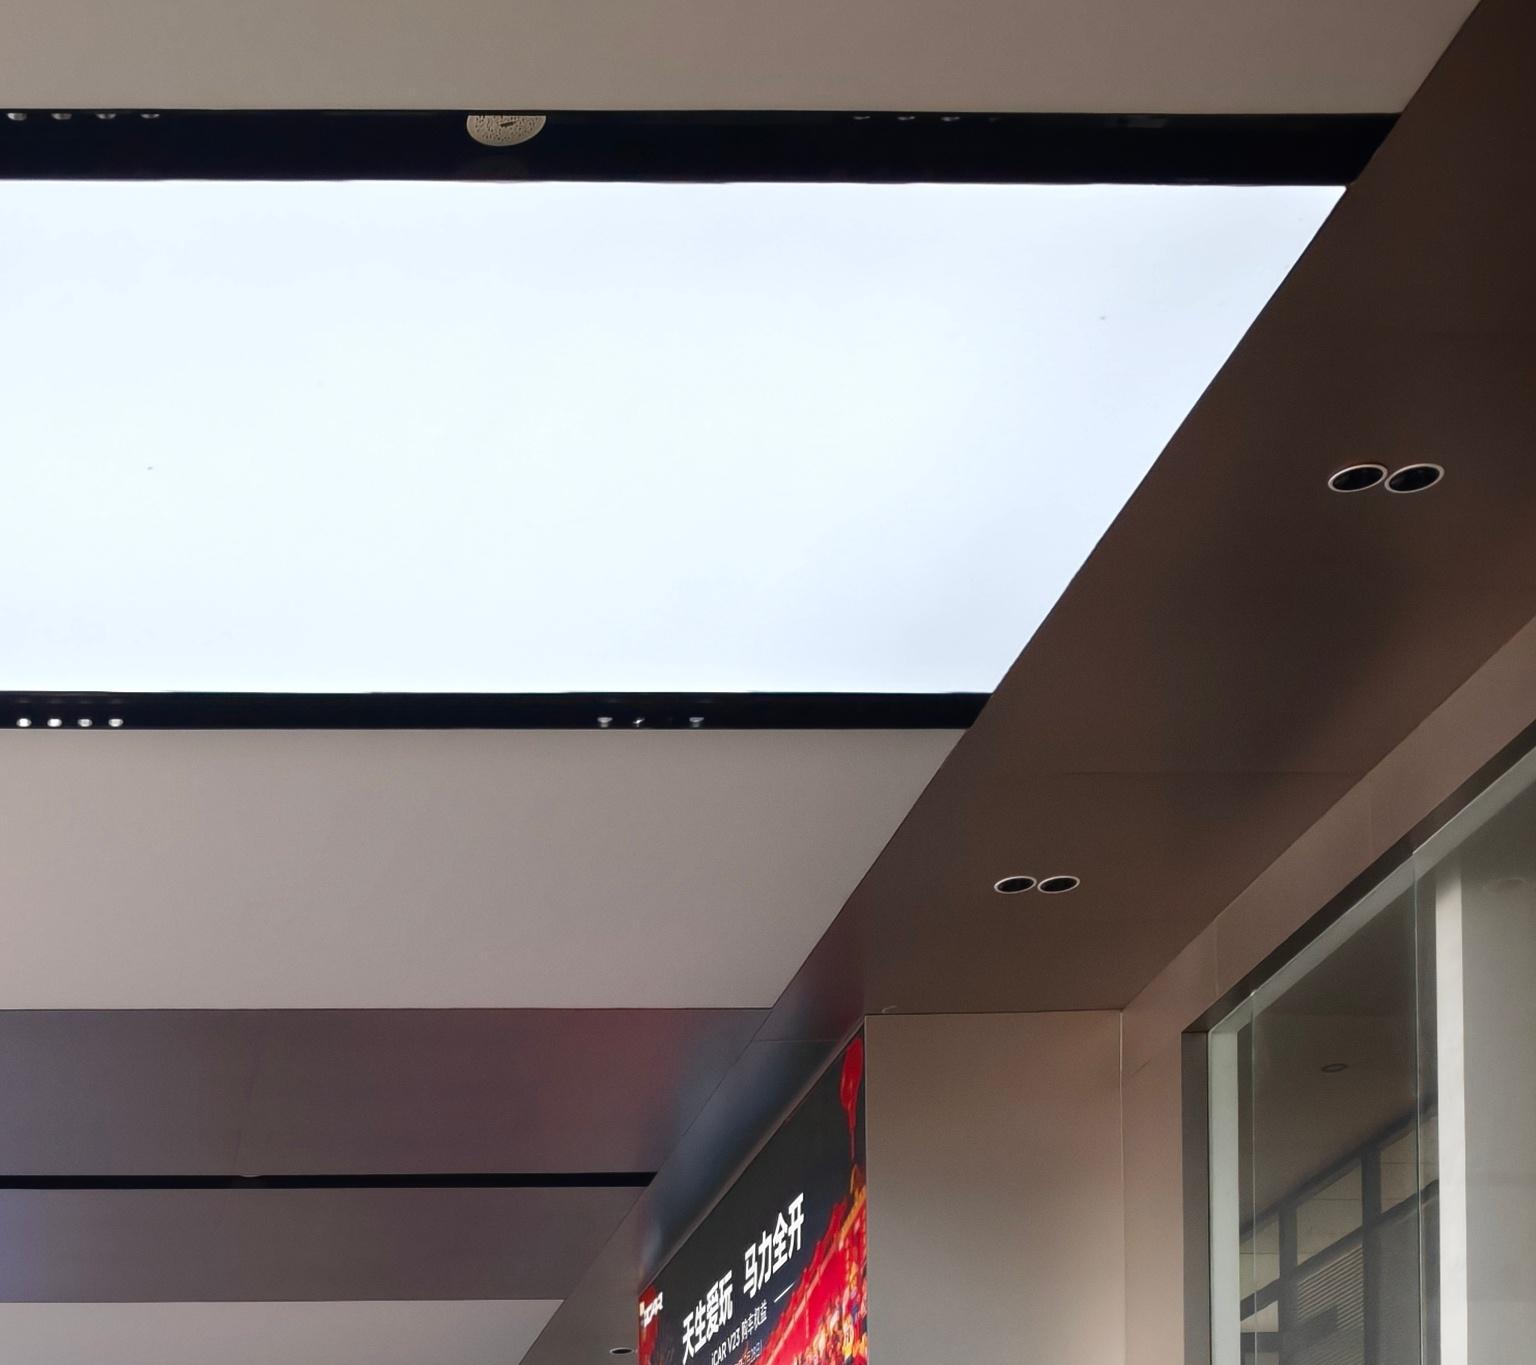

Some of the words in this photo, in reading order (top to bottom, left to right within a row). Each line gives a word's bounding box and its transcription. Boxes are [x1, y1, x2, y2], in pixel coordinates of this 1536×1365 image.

[743, 1192, 804, 1299] 马力全开
[727, 1327, 741, 1354] V23
[741, 1299, 768, 1343] 购车权益
